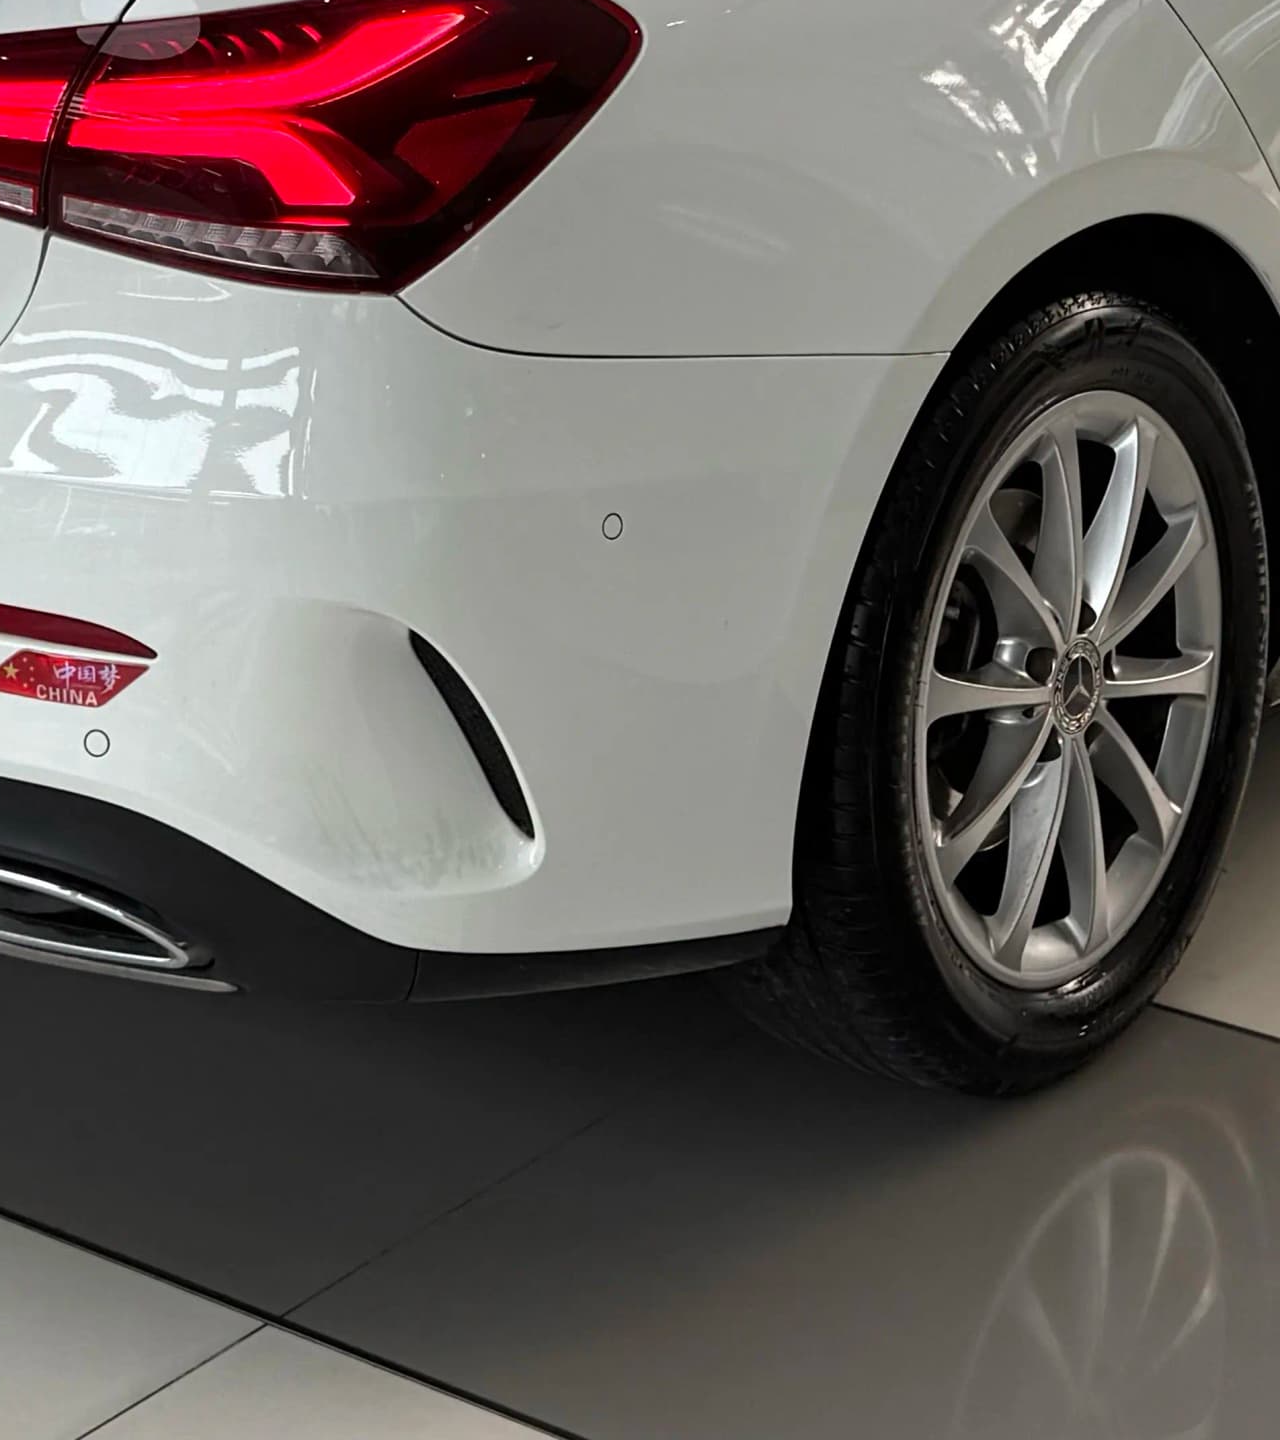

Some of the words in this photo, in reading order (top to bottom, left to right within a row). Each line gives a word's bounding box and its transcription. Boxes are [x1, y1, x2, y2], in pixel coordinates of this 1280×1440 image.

[52, 660, 121, 695] 中国梦
[35, 683, 99, 707] CHINA
